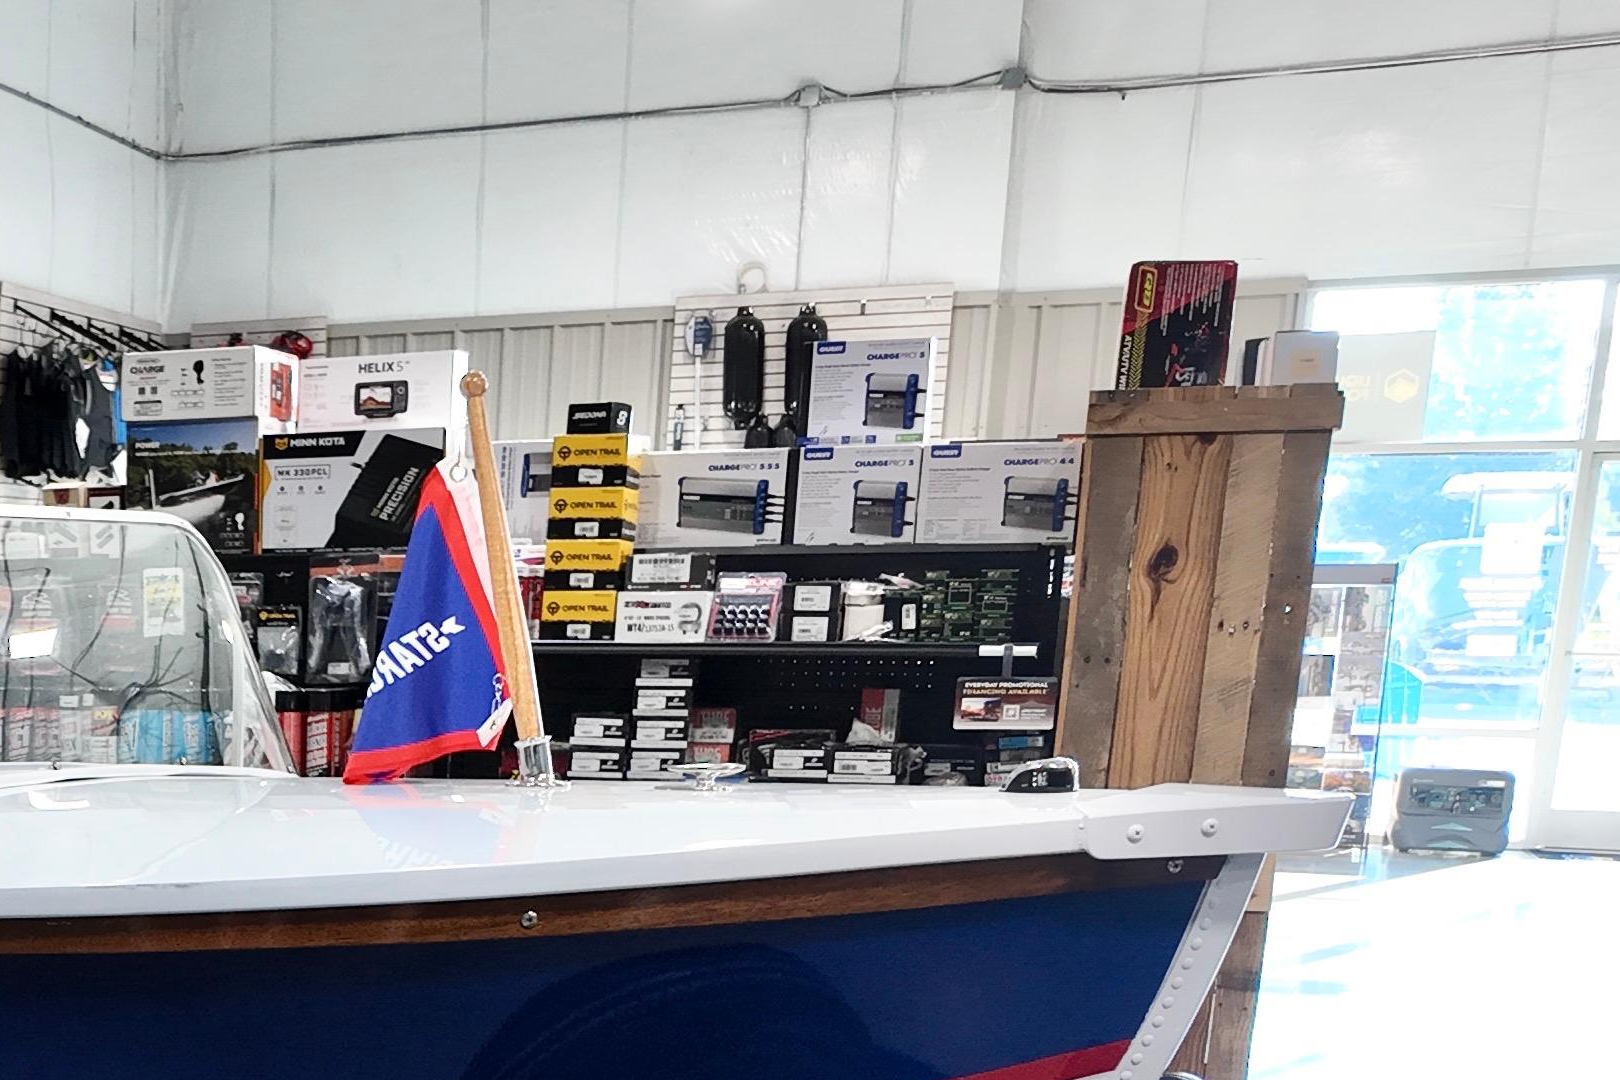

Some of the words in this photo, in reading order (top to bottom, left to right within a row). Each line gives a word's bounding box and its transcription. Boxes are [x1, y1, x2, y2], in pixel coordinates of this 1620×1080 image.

[358, 361, 396, 374] HELIX
[290, 438, 317, 448] MINN
[318, 436, 346, 446] KOTA
[573, 449, 598, 457] OPEN
[599, 448, 622, 456] TRAIL
[379, 467, 420, 521] PRECISION
[570, 502, 594, 510] OPEN
[595, 501, 618, 509] TRAIL
[566, 553, 590, 561] OPEN
[591, 553, 613, 561] TRAIL
[562, 604, 586, 612] OPEN
[587, 604, 609, 612] TRAIL
